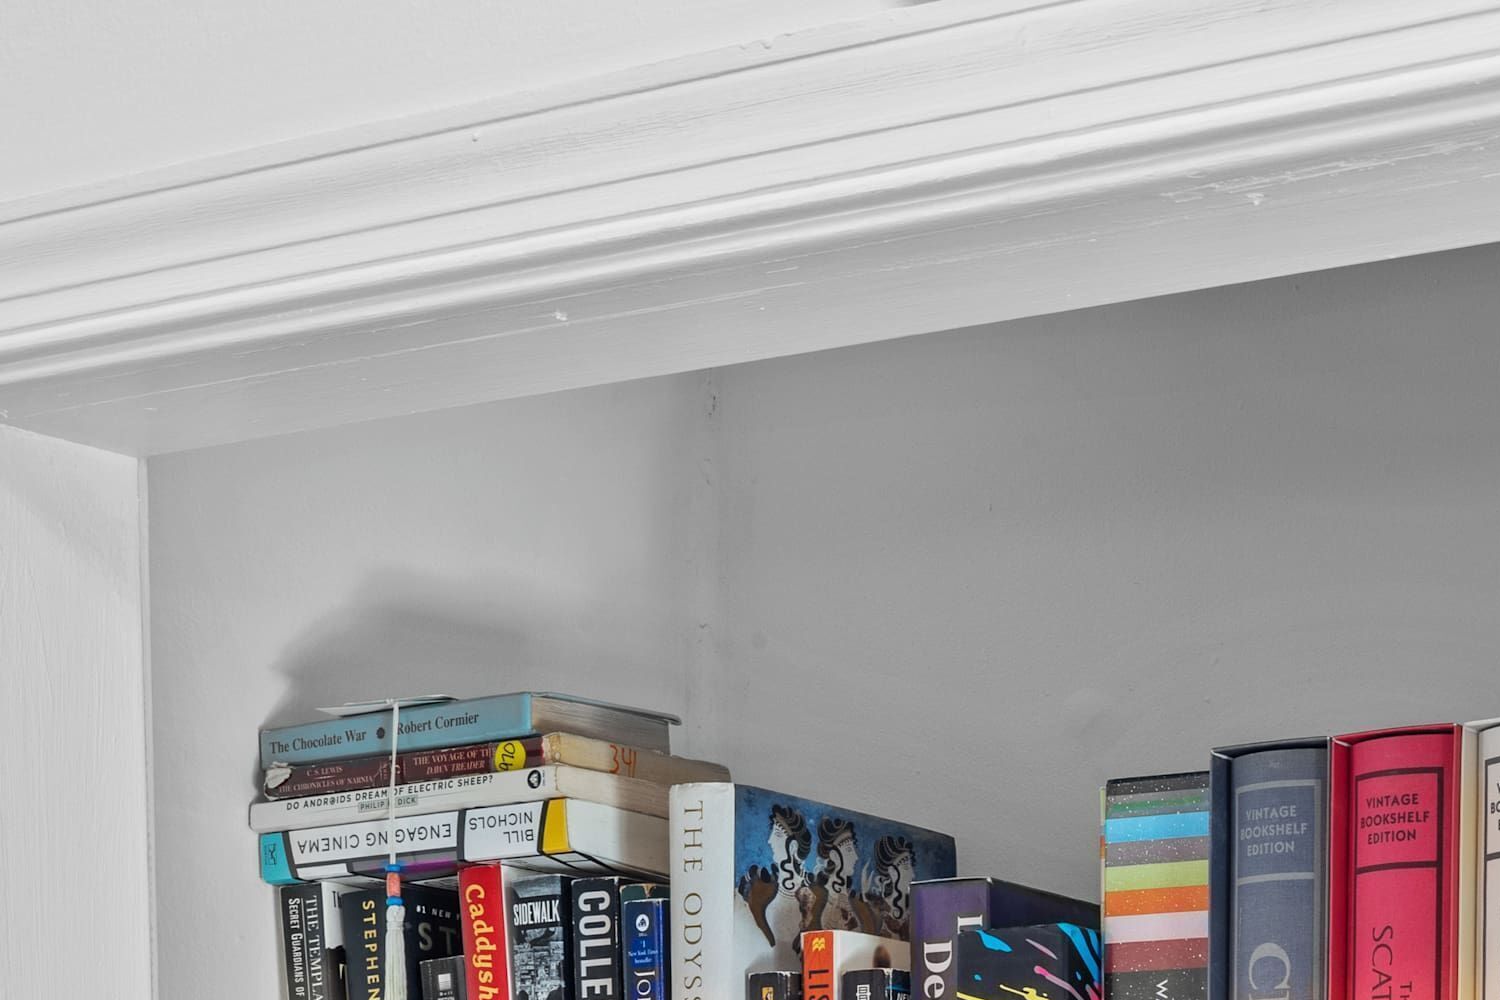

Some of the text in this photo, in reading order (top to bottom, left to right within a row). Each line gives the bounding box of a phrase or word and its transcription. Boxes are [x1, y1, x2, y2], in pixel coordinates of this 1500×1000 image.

[397, 712, 480, 736] Robert Cormier
[270, 730, 367, 754] The Chocolate War
[431, 751, 465, 764] VOYAGE
[286, 801, 300, 811] DO
[355, 789, 388, 802] DREAM
[408, 781, 454, 795] ELECTRIC
[457, 775, 494, 787] SHEEP?
[397, 797, 416, 806] DICK
[1366, 793, 1419, 809] VINTAGE
[360, 801, 385, 811] PHILIP
[1246, 805, 1297, 821] VINTAGE
[469, 812, 533, 831] NICHOLS
[1360, 811, 1430, 829] BOOKSHELF
[366, 823, 452, 847] ENGAGNG
[503, 828, 535, 843] BILL
[683, 800, 704, 872] THE
[1240, 823, 1309, 841] BOOKSHELF
[1367, 829, 1417, 845] EDITION
[297, 833, 360, 855] CINEMA
[1247, 841, 1296, 857] EDITION
[288, 897, 300, 930] SECRET
[305, 895, 319, 932] THE
[513, 899, 560, 926] SIDEWALK
[291, 933, 305, 983] GUARDIANS
[295, 986, 305, 997] OF
